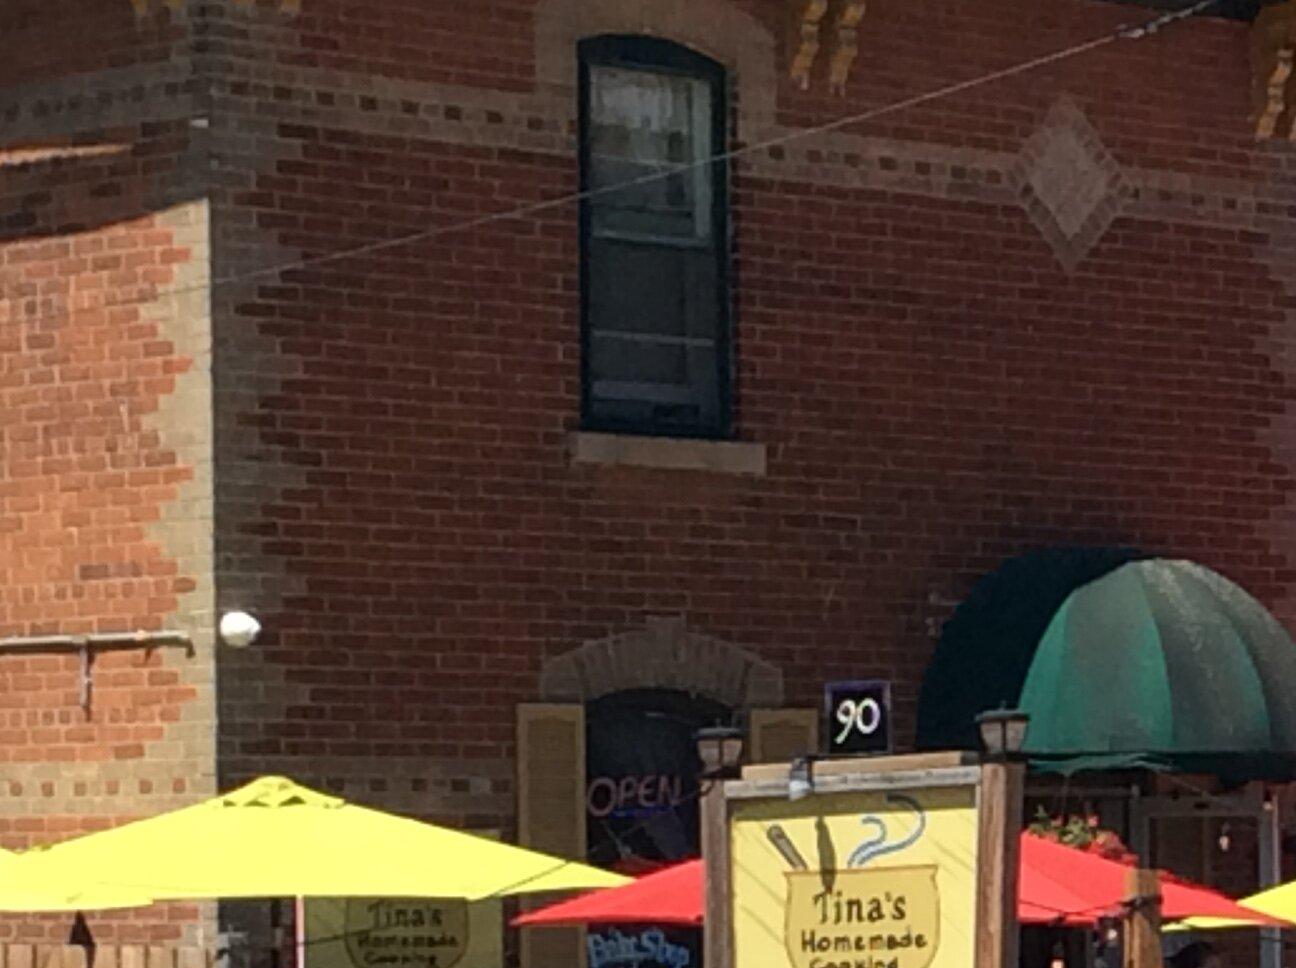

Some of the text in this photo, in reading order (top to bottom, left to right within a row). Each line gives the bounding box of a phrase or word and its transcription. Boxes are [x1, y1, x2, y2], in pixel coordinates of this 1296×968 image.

[834, 697, 881, 744] 90
[588, 775, 682, 817] OPEN
[812, 889, 906, 925] Tina's
[801, 926, 927, 953] Homemade
